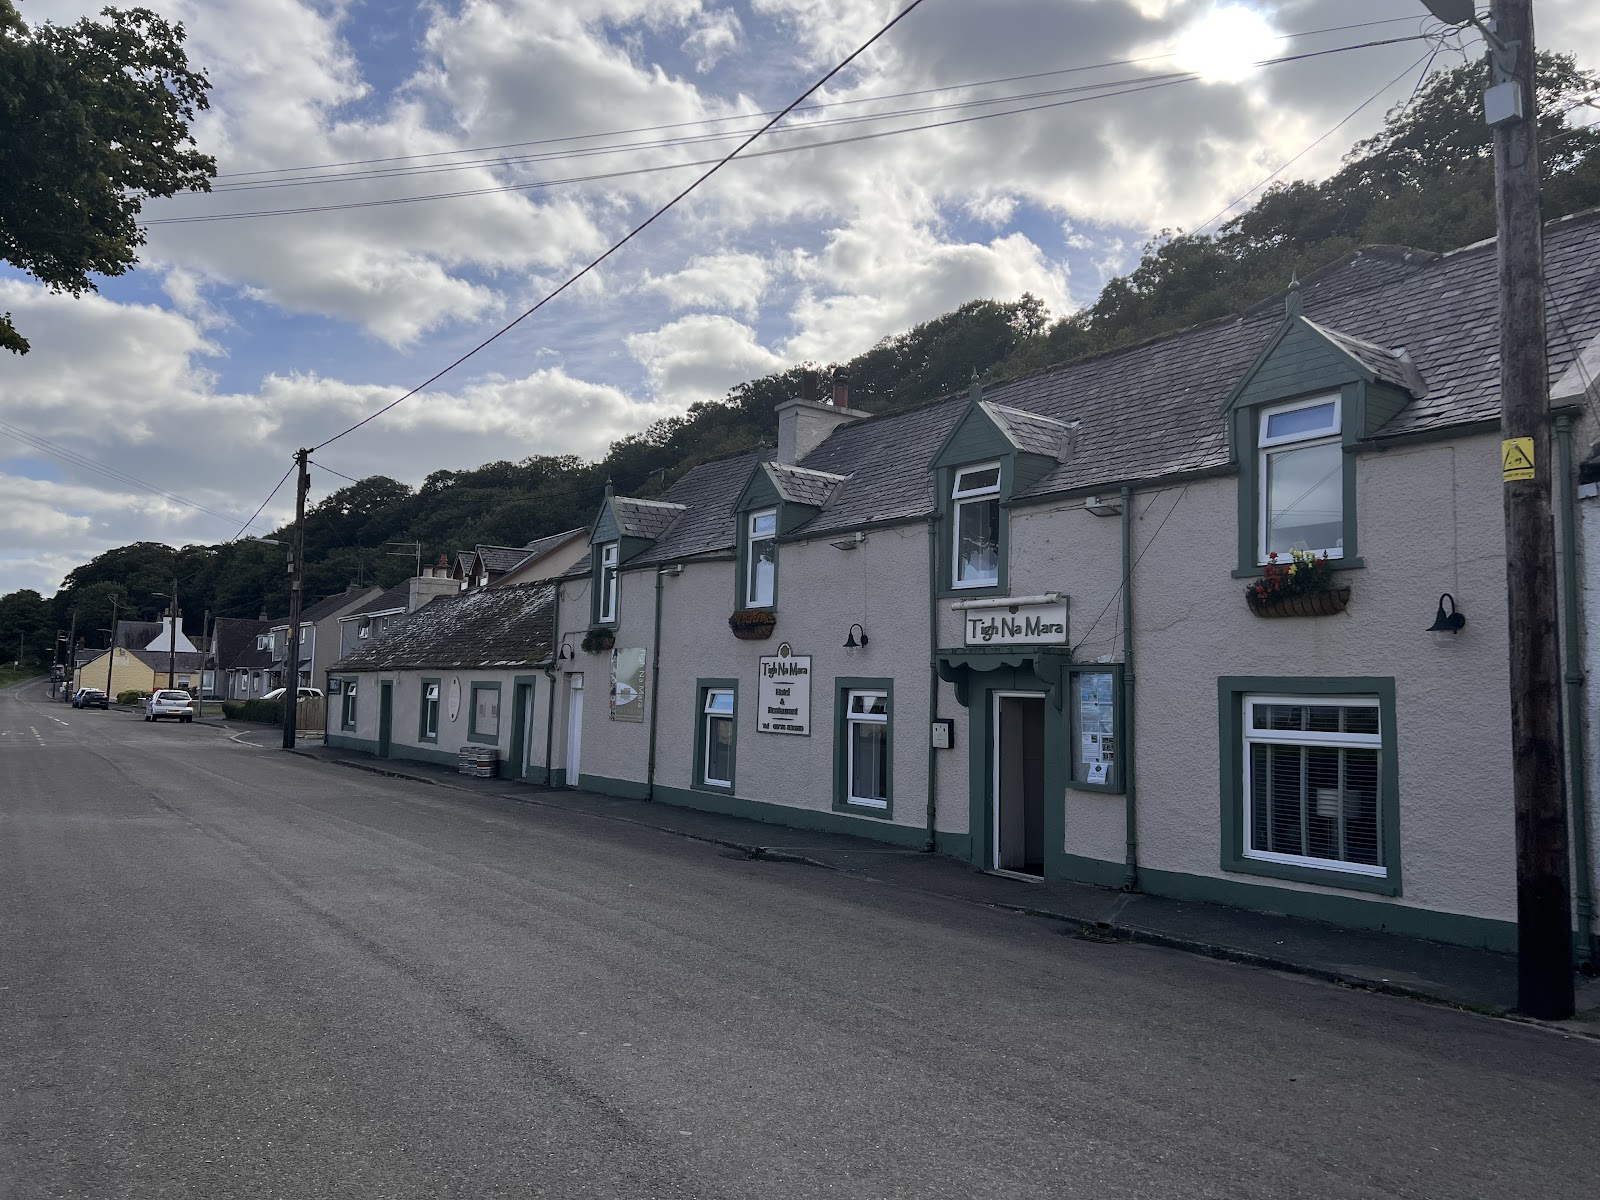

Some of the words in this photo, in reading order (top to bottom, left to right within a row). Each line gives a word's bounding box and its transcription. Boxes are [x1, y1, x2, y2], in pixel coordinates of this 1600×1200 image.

[967, 617, 999, 641] Tigh
[1001, 617, 1022, 638] Na
[1025, 616, 1063, 637] Mara
[639, 670, 645, 683] Na
[761, 662, 777, 678] Tigh
[778, 662, 788, 676] Na
[789, 662, 808, 676] Mara
[775, 688, 790, 696] Hotel
